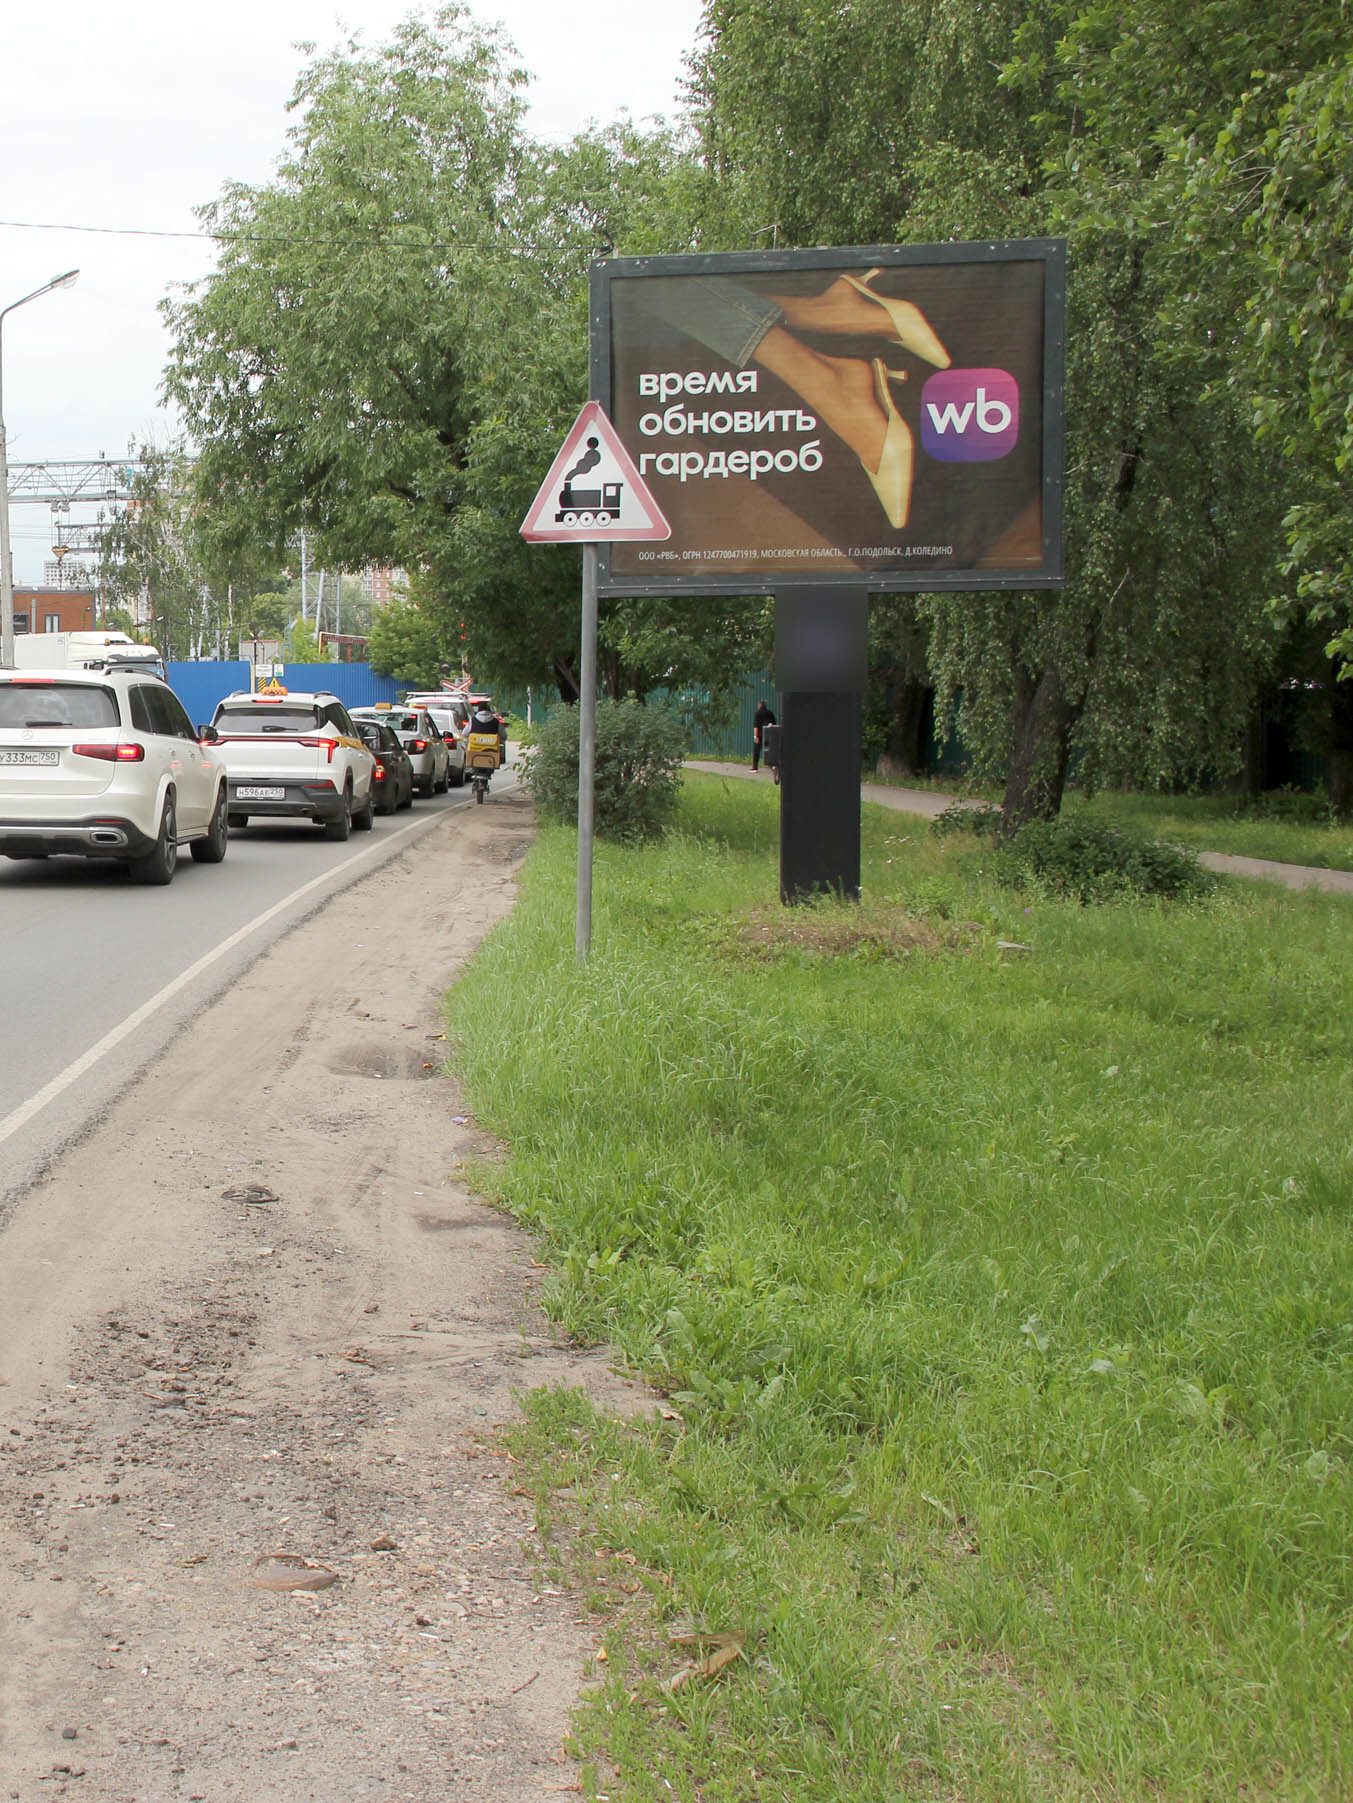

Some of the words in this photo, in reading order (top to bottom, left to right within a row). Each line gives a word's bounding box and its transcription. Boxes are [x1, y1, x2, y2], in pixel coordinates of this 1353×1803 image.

[638, 370, 758, 403] время
[638, 403, 817, 437] обновить
[926, 387, 1012, 435] wb
[638, 440, 824, 482] гардероб
[638, 551, 655, 560] ООО
[682, 550, 701, 560] ОГРН
[40, 752, 56, 761] 750
